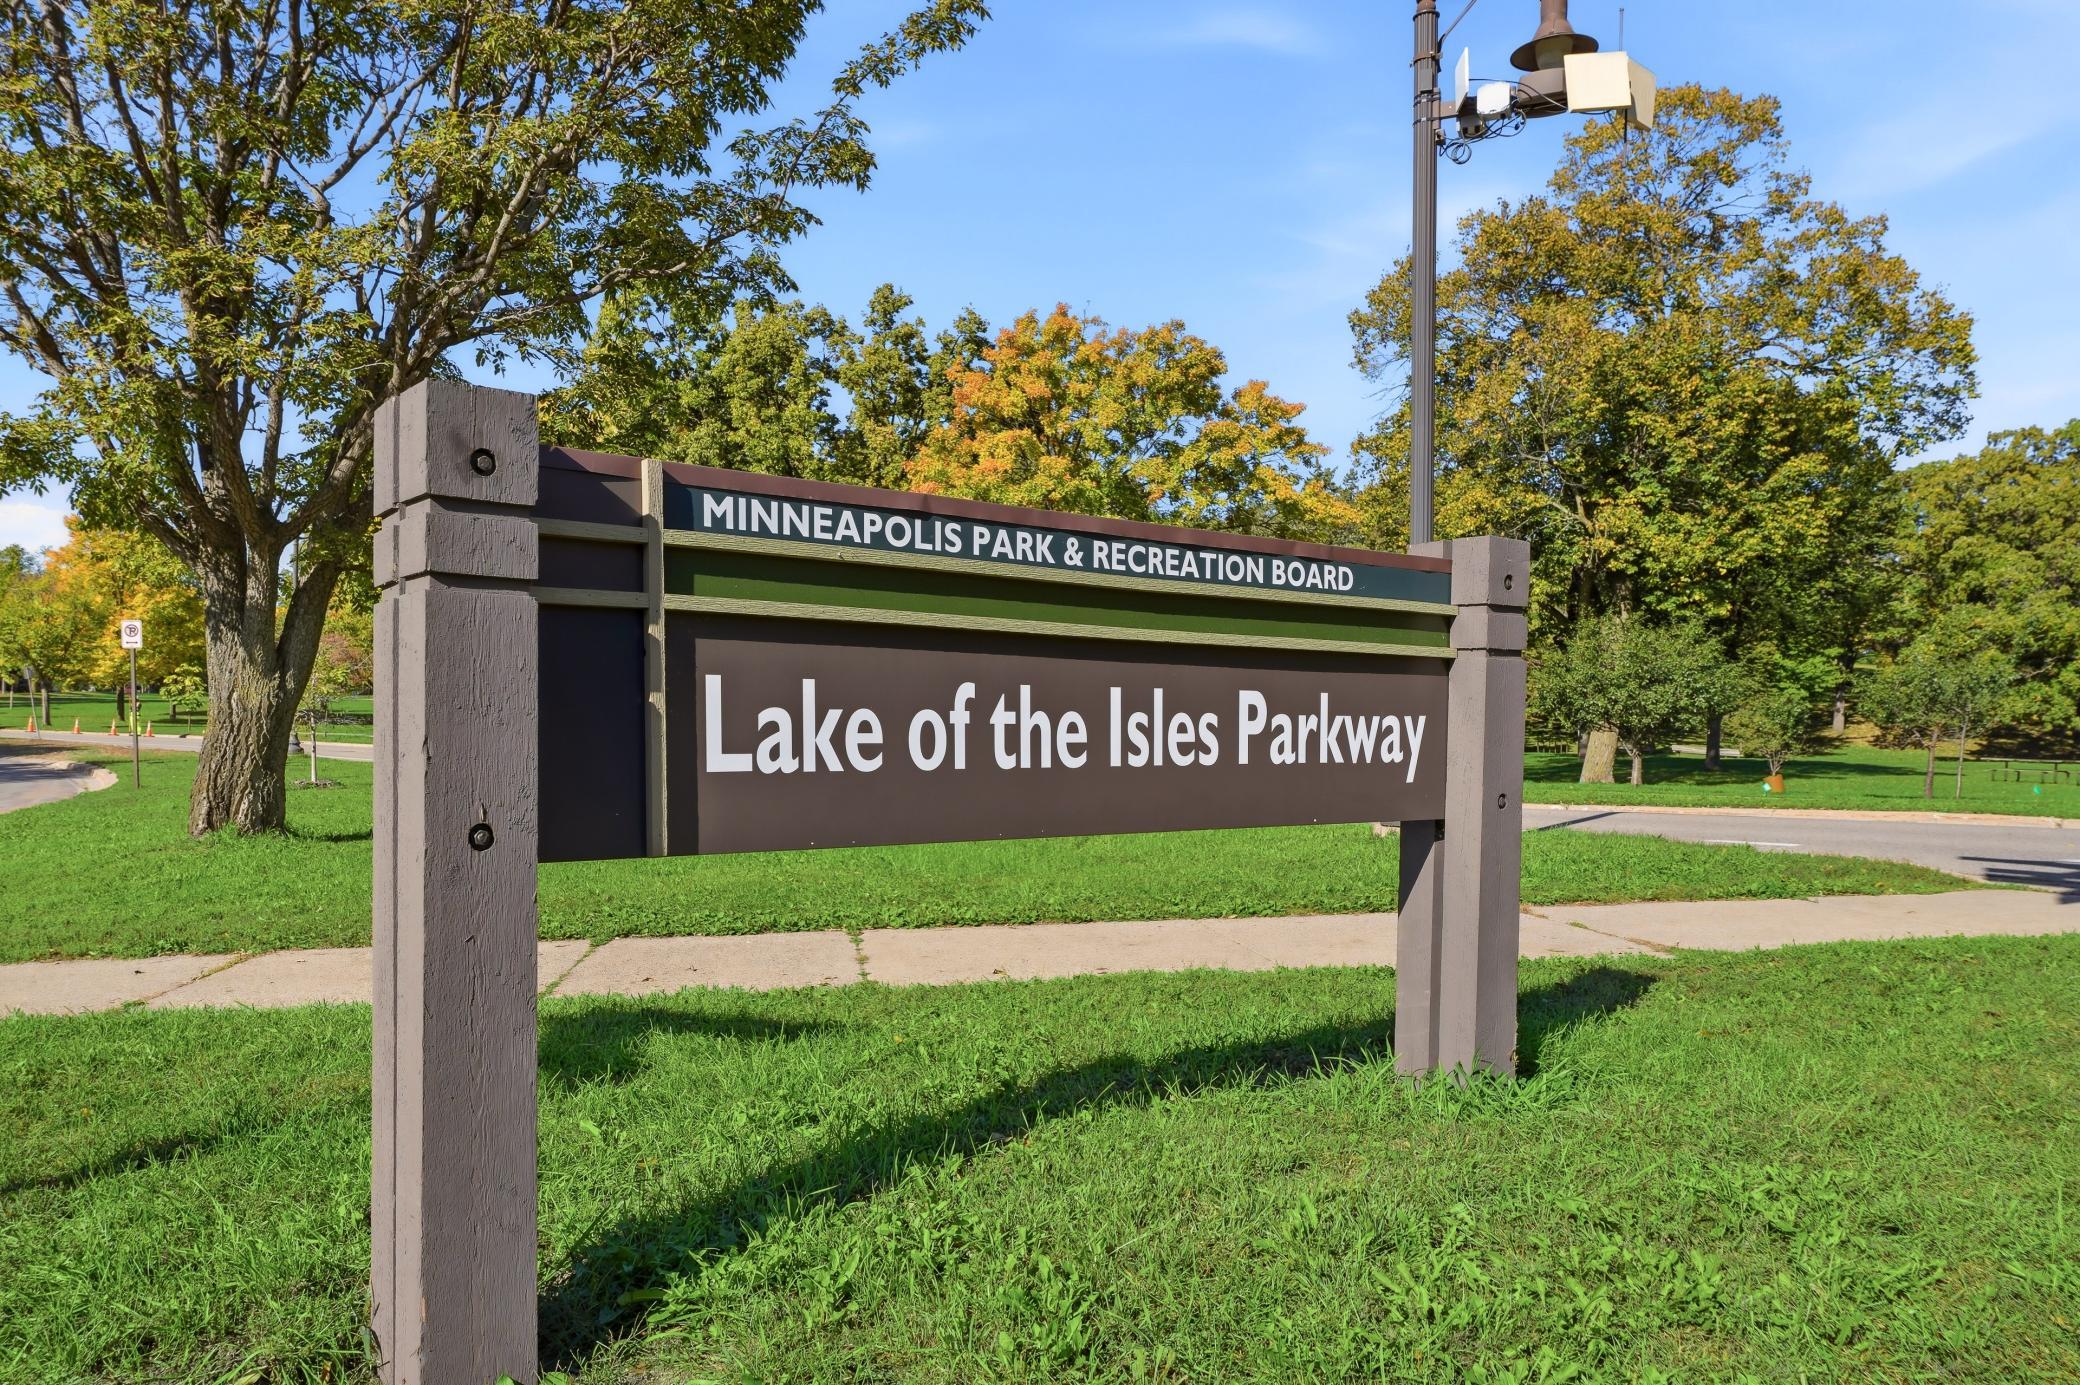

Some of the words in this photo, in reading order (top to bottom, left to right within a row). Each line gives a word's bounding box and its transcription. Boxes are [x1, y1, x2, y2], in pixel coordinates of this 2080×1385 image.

[703, 493, 963, 554] MINNEAPOLIS
[973, 525, 1056, 564] PARK
[1063, 537, 1084, 567] &
[1093, 540, 1264, 584] RECREATION
[1272, 559, 1354, 591] BOARD
[704, 674, 884, 775] Lake
[908, 682, 976, 772] of
[989, 684, 1088, 770] the
[1109, 686, 1219, 768] Isles
[1238, 689, 1427, 785] Parkway
